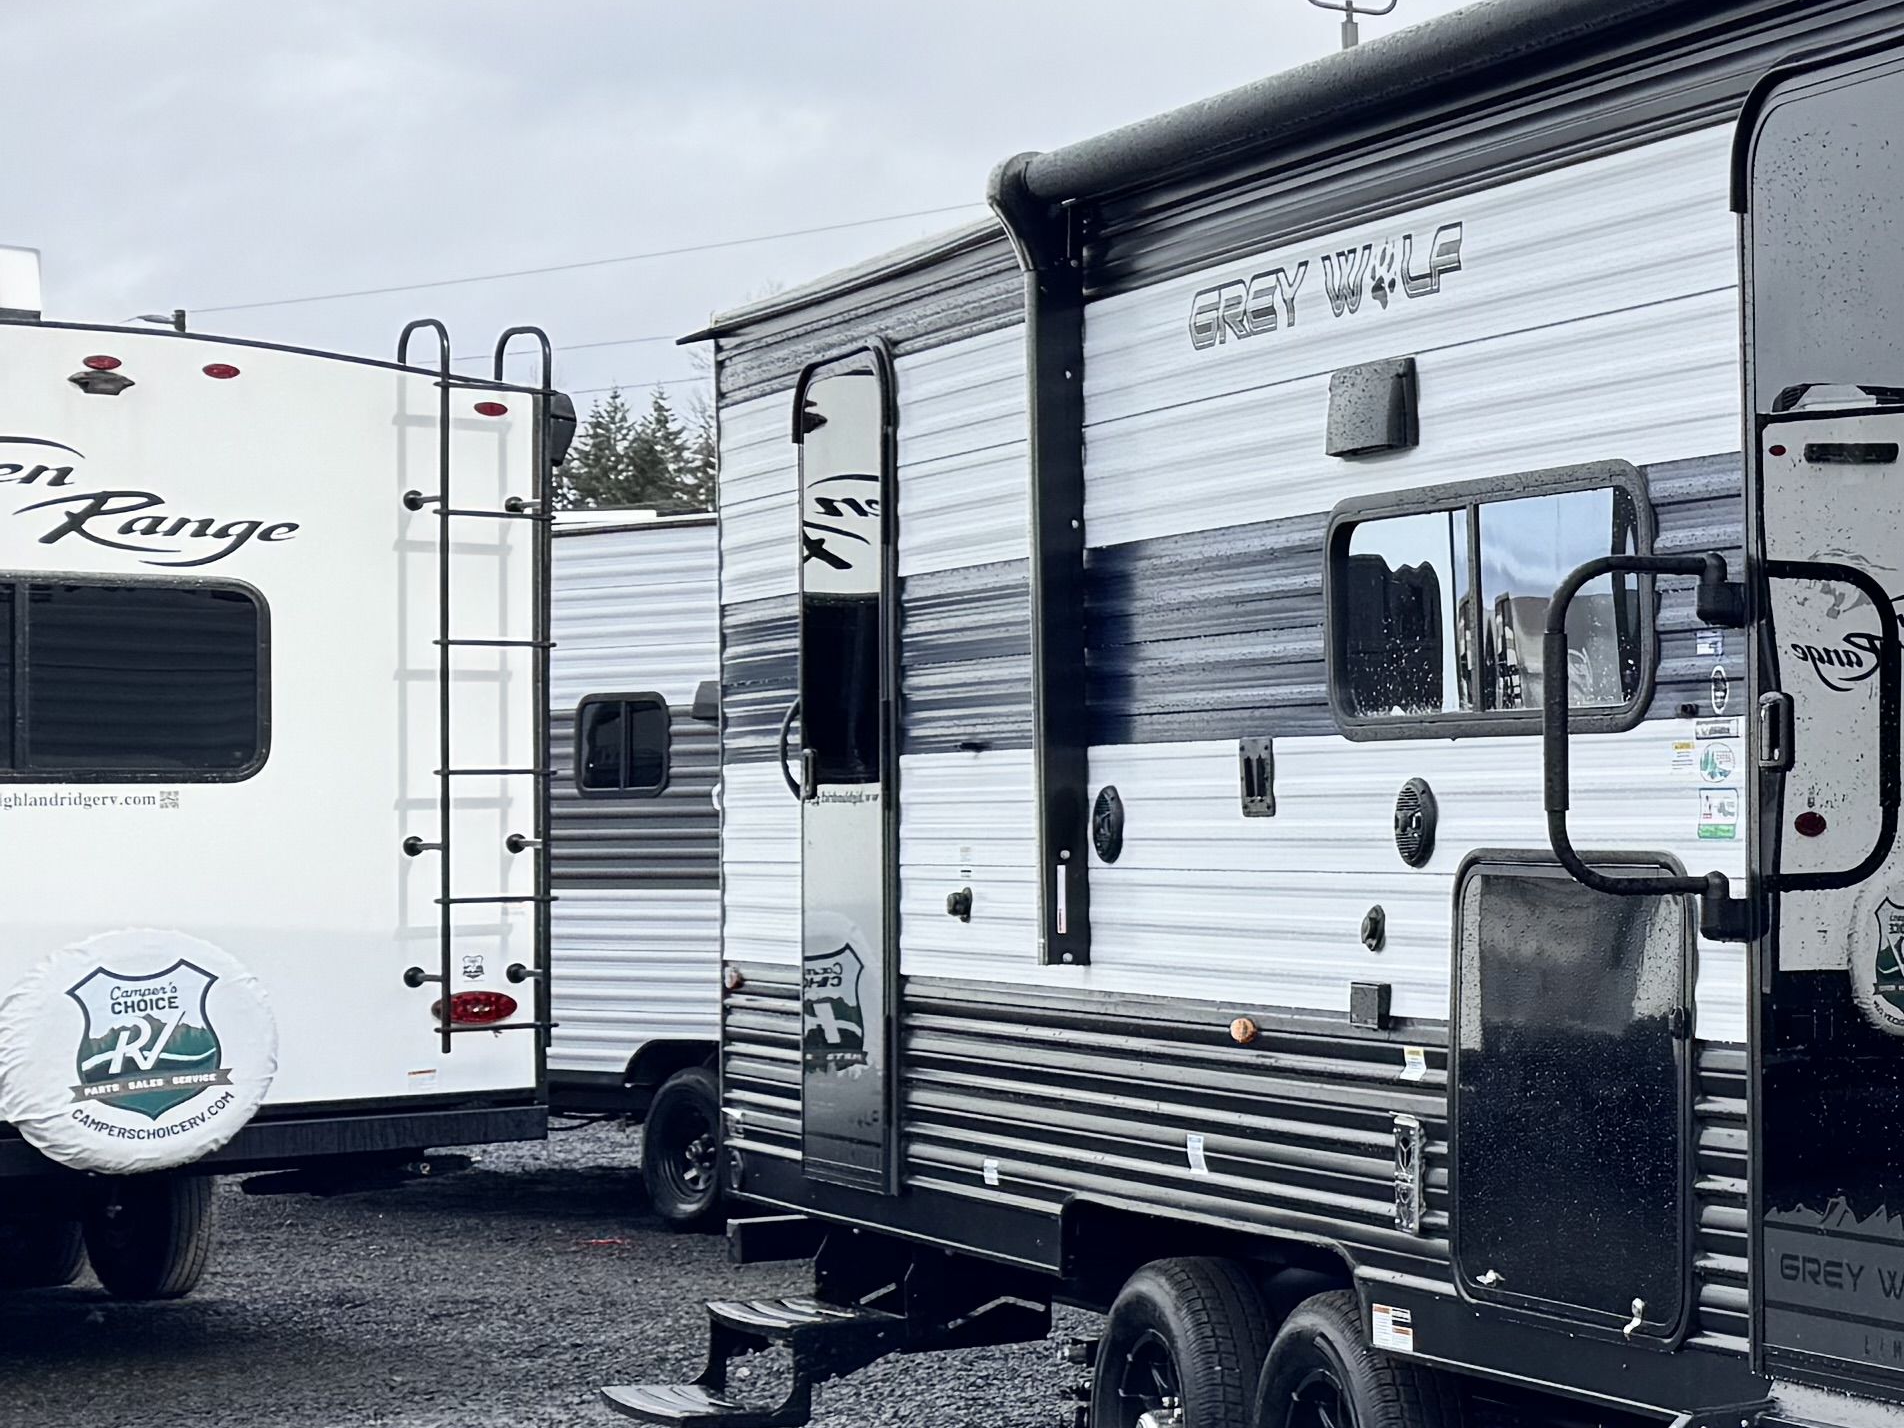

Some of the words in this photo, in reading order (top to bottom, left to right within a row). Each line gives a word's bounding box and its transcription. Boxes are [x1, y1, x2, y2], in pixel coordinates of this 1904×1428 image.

[1189, 260, 1309, 351] GREY
[12, 490, 300, 567] Range
[110, 982, 178, 1001] Camper's
[110, 996, 180, 1015] CHOICE
[84, 1083, 120, 1097] PARTS
[128, 1078, 165, 1090] SALES
[172, 1073, 217, 1085] SERVICE
[71, 1091, 236, 1140] CAMPERSCHOICERV.COM
[1779, 1252, 1865, 1293] GREY
